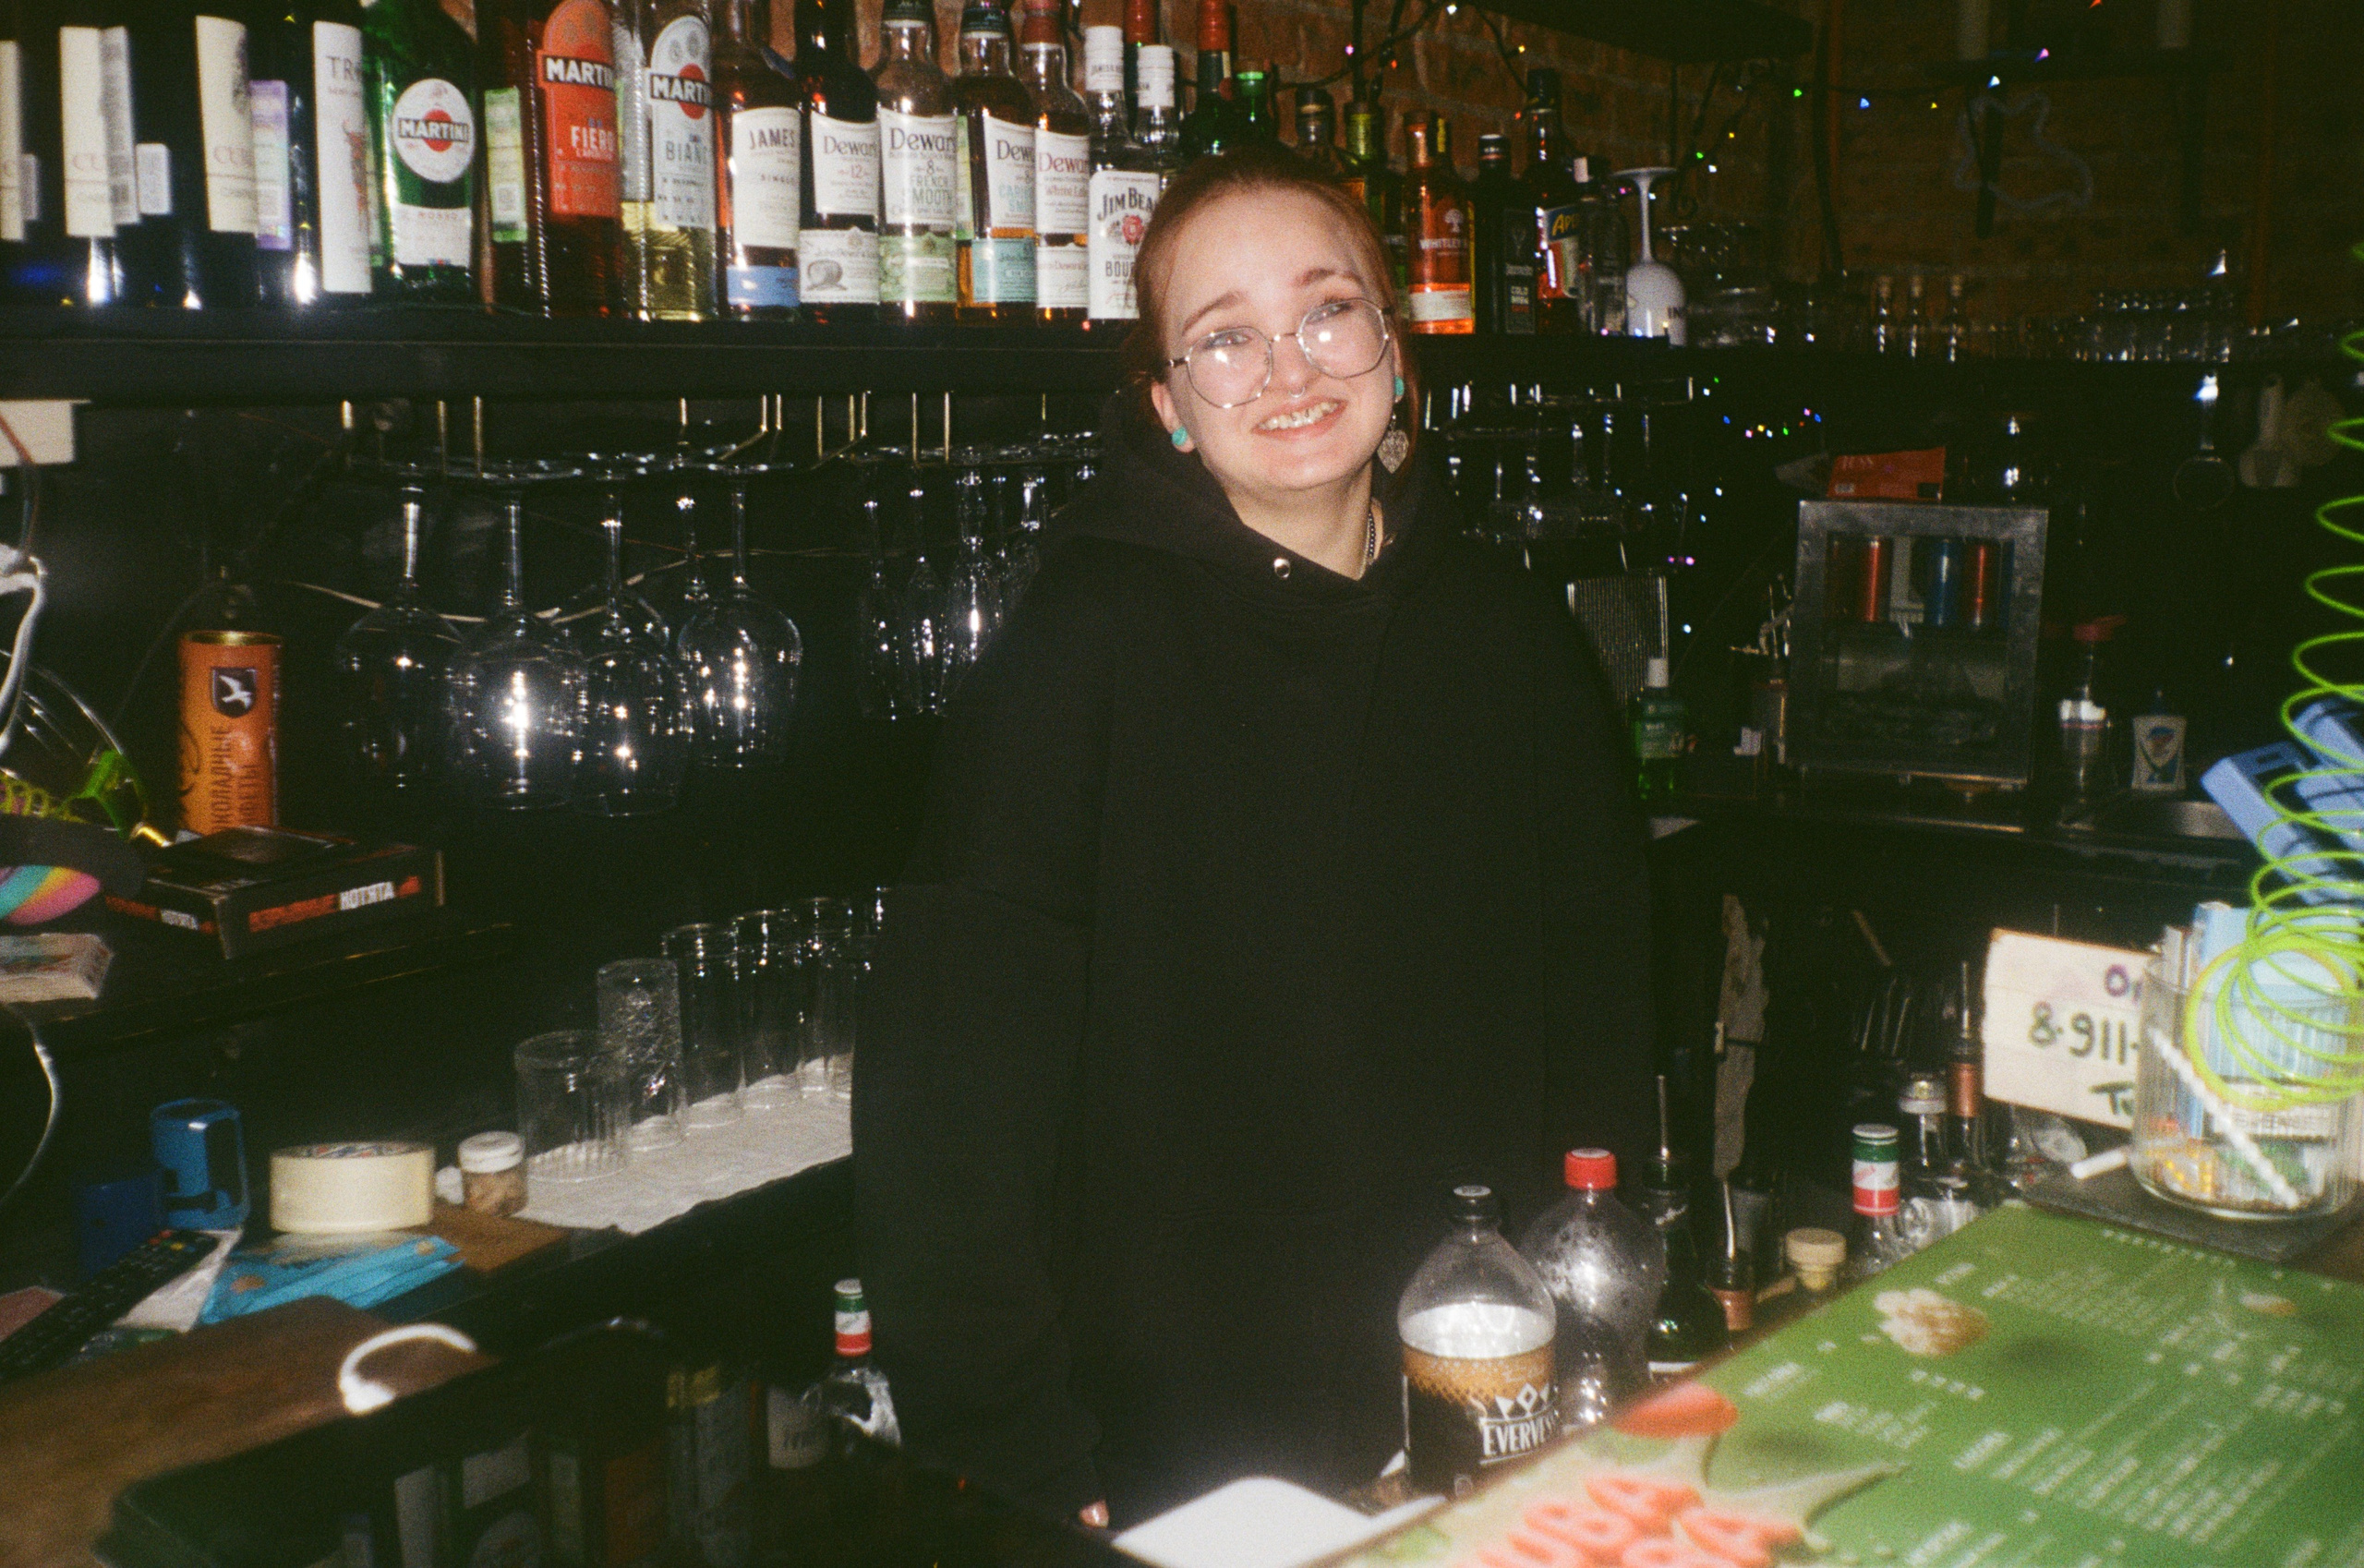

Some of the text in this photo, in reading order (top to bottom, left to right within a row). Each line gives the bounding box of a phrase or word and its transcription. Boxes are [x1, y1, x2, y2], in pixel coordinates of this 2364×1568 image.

[547, 56, 614, 89] MARTIN
[400, 119, 468, 142] MARTINI
[1096, 192, 1126, 221] JIM
[1128, 187, 1156, 211] BEA
